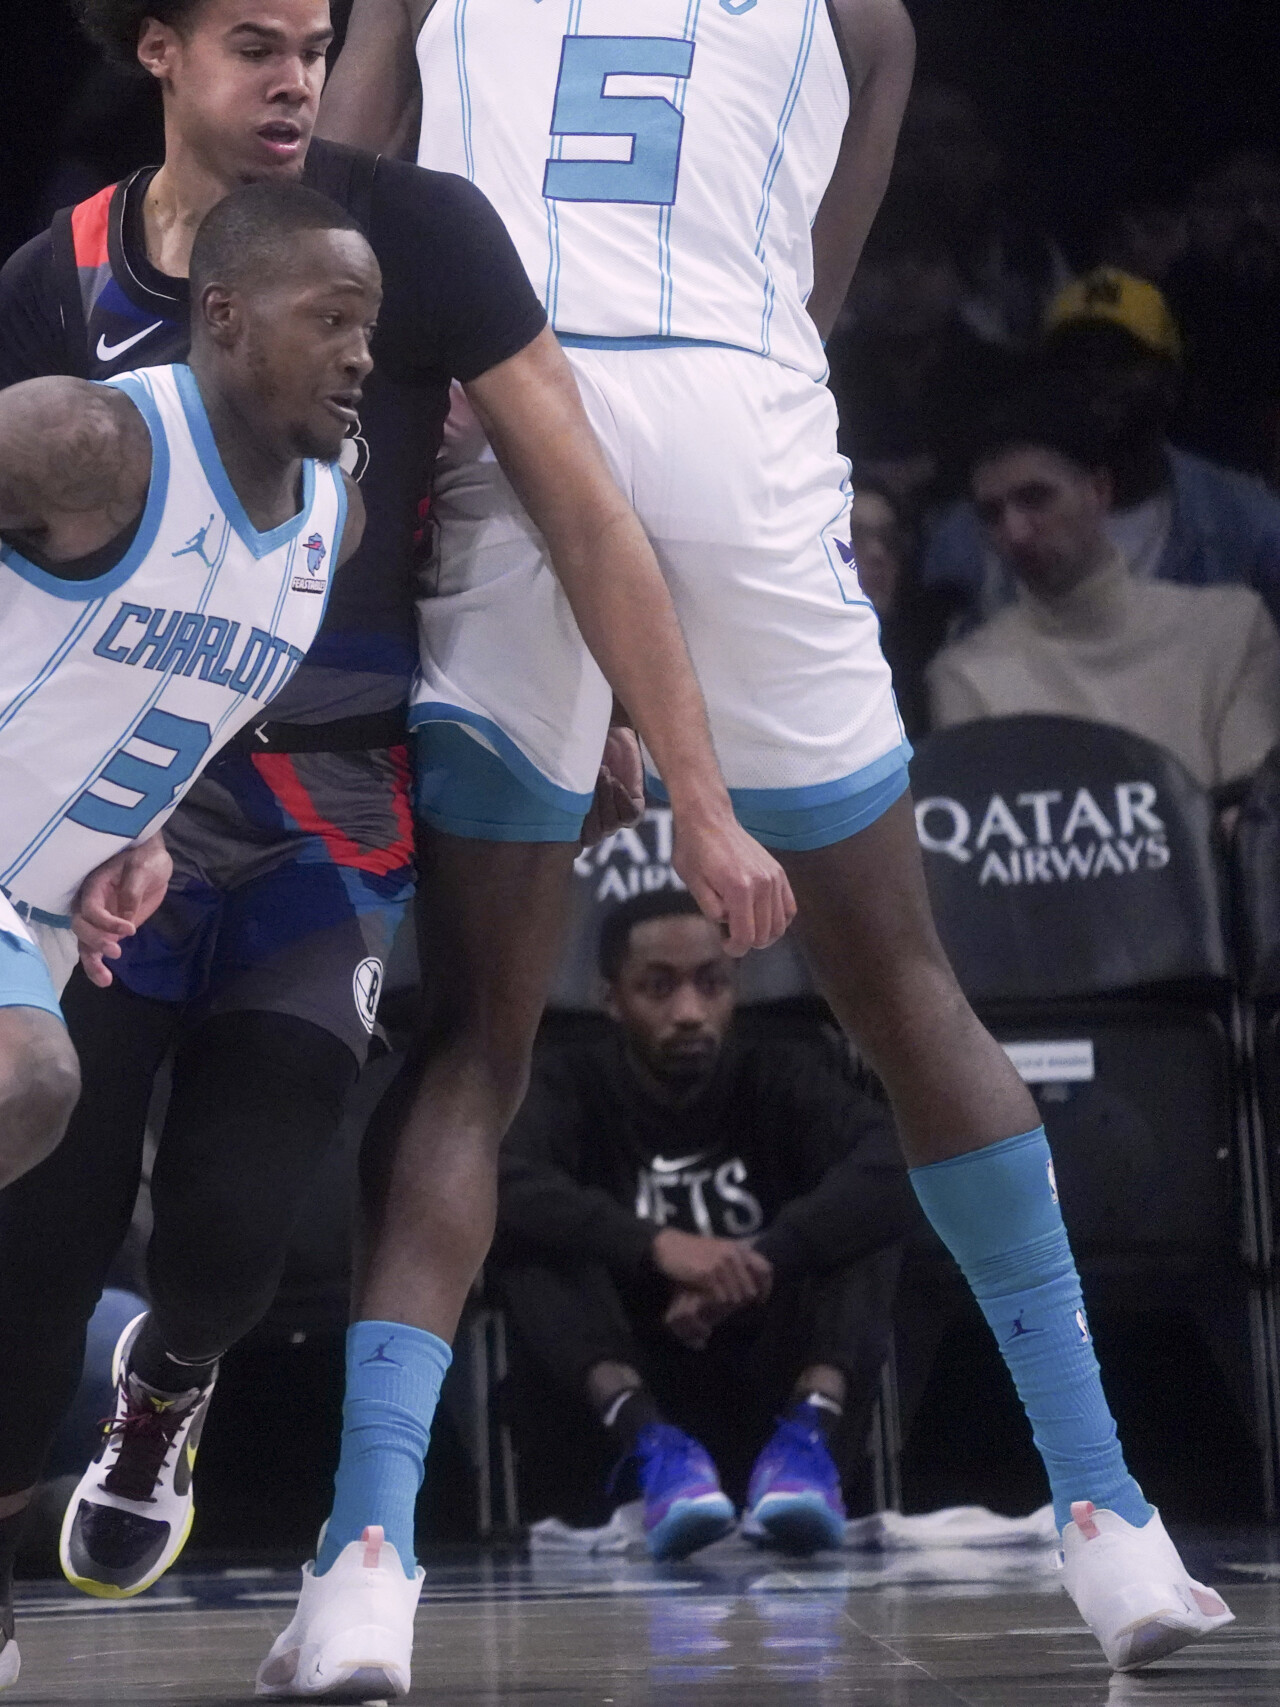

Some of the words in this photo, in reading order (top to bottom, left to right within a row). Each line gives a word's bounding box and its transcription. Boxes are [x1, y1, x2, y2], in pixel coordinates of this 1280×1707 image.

[542, 35, 695, 206] 5
[93, 602, 306, 704] CHARLOTT
[64, 707, 212, 839] 3
[914, 782, 1165, 863] QATAR
[978, 833, 1170, 886] AIRWAYS
